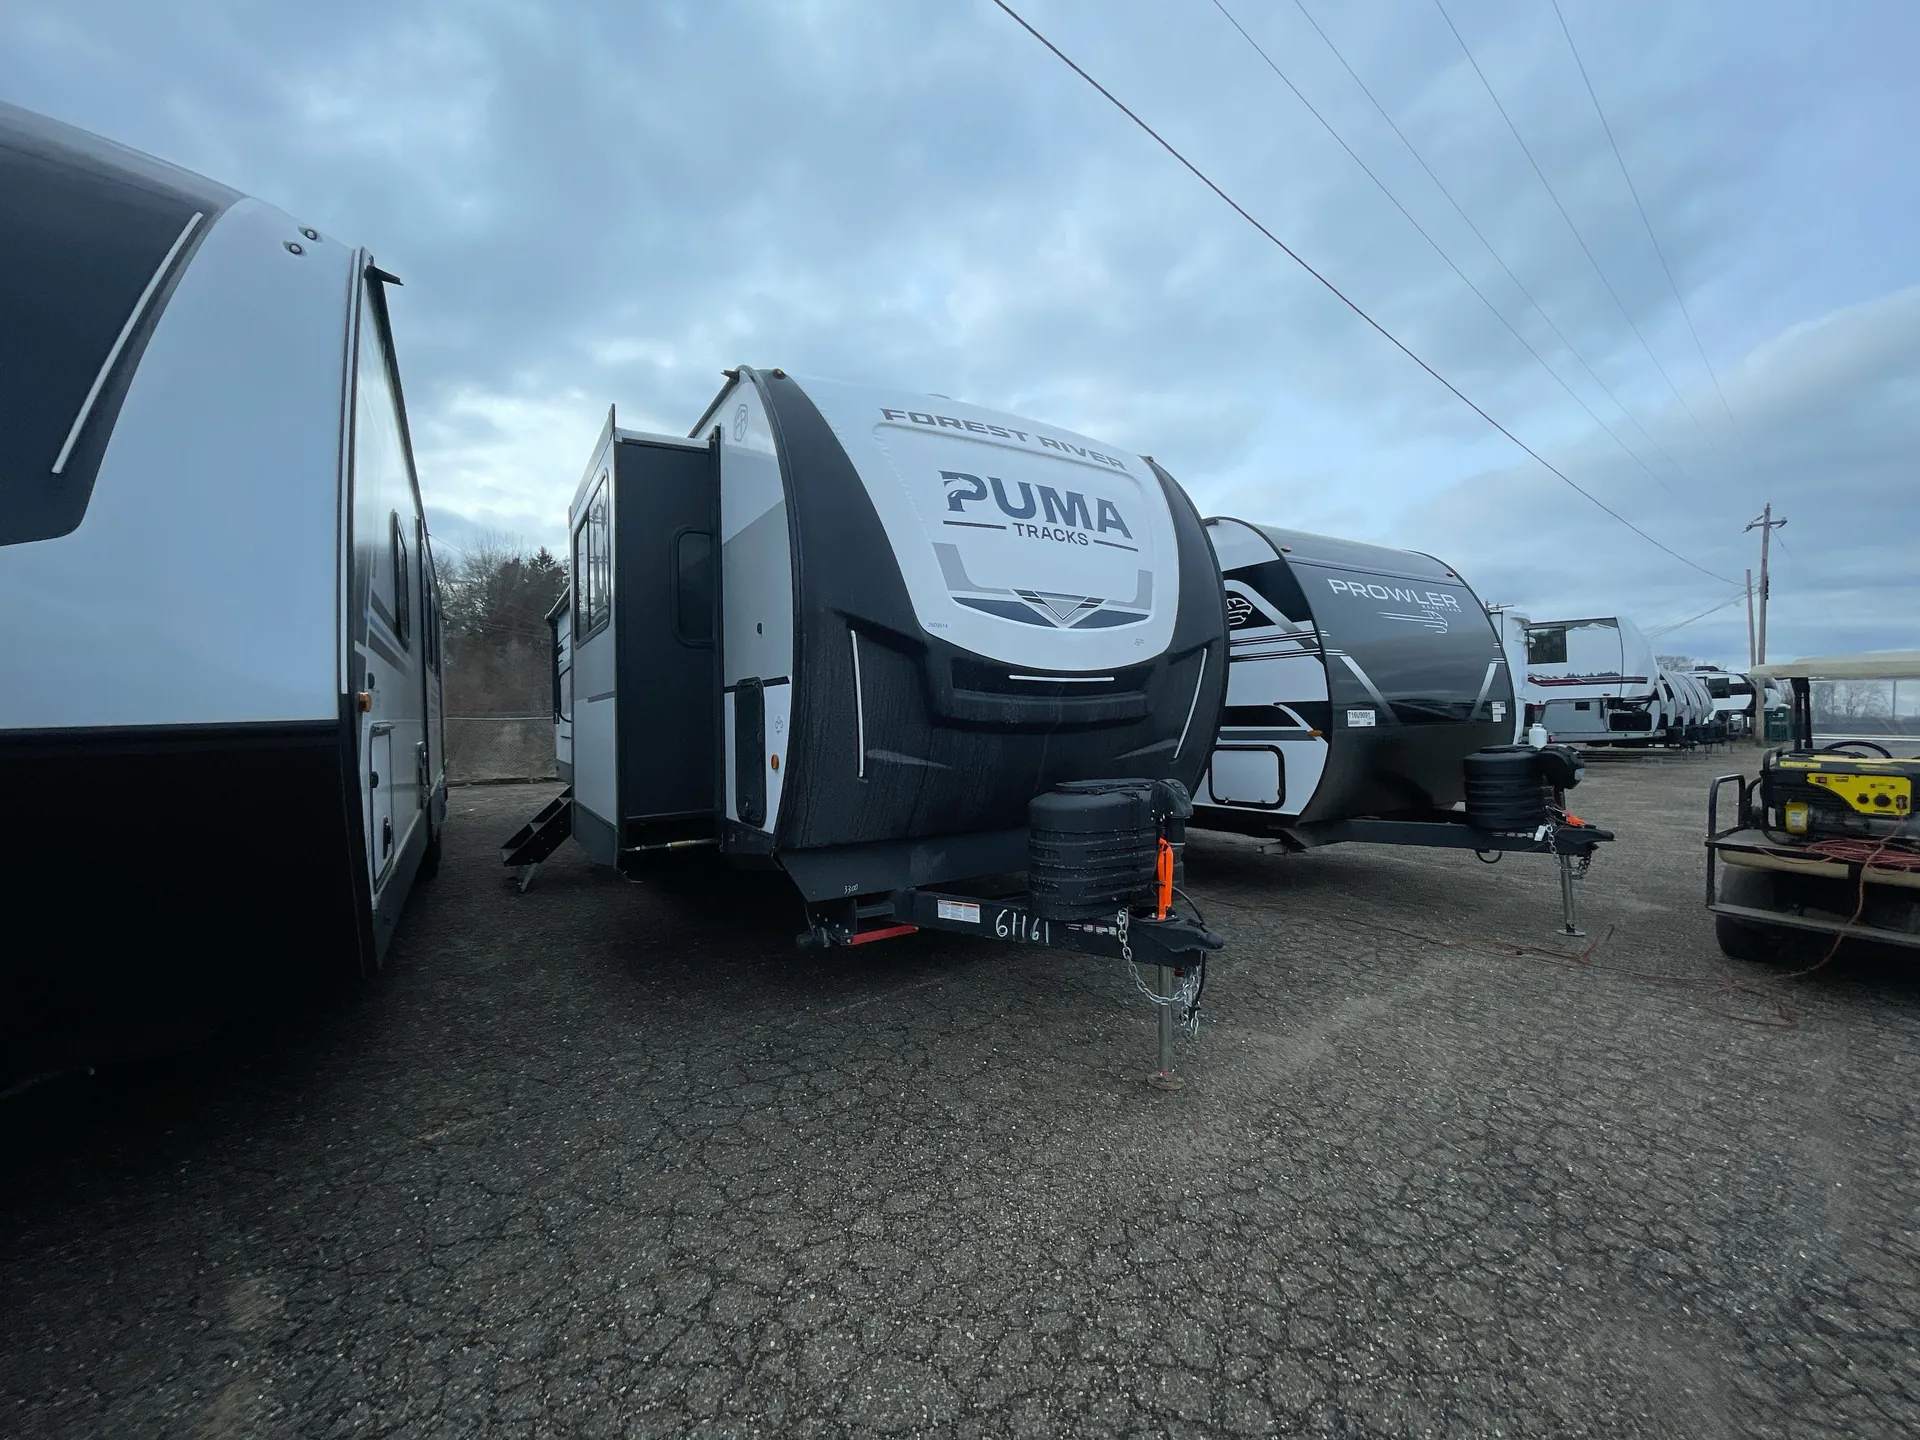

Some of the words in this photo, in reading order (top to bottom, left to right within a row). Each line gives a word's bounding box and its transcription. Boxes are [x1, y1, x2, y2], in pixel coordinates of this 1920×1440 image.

[879, 407, 1030, 443] FOREST
[1036, 435, 1127, 471] RIVER
[938, 470, 1134, 540] PUMA
[1012, 522, 1089, 546] TRACKS
[1327, 578, 1458, 609] PROWLER
